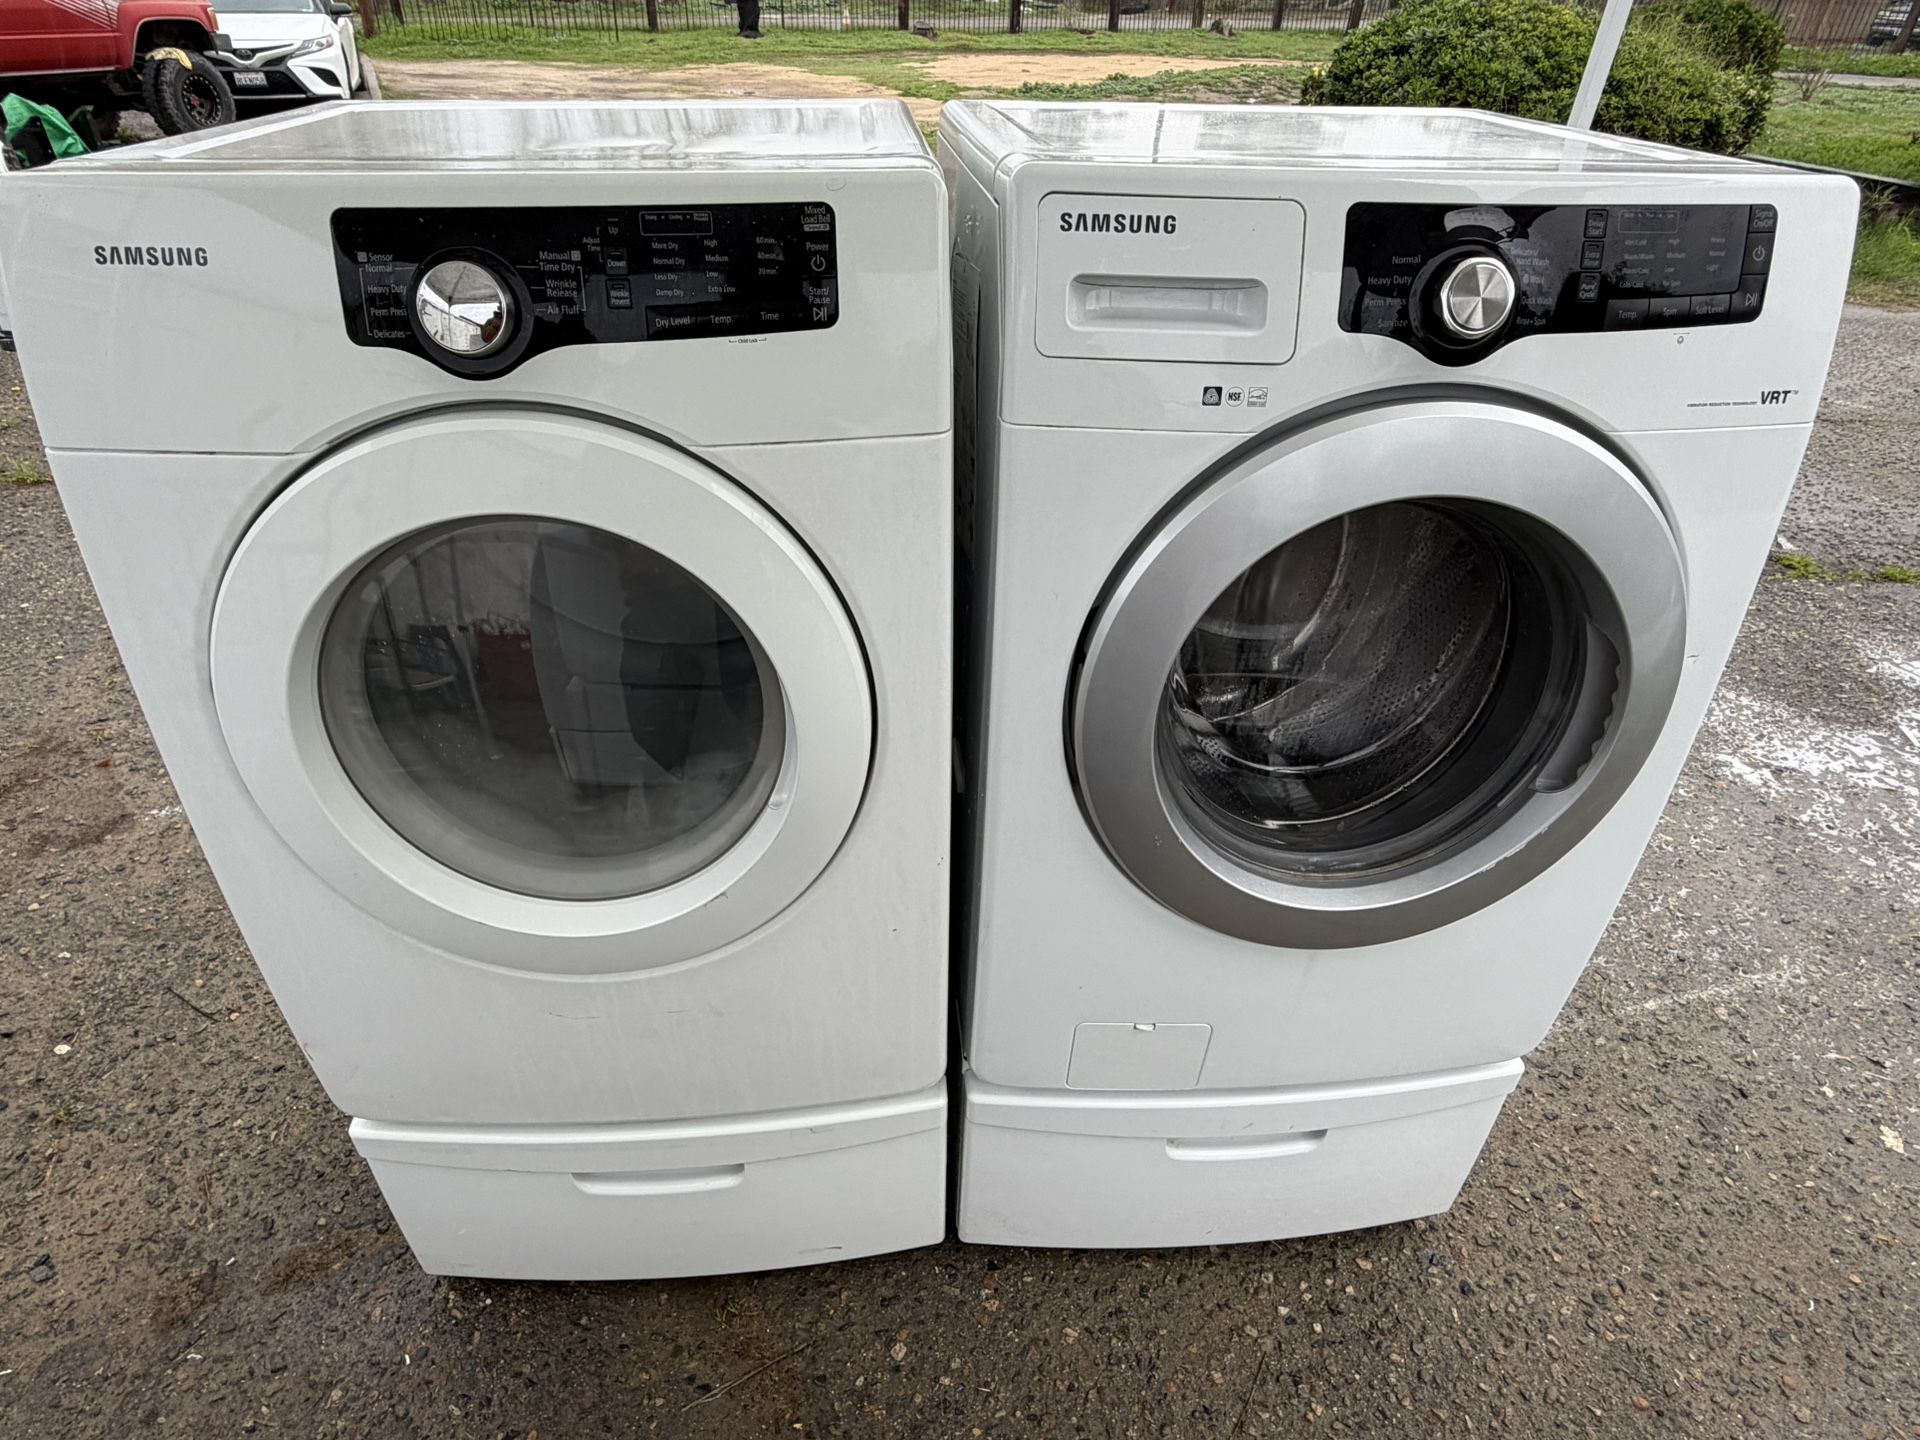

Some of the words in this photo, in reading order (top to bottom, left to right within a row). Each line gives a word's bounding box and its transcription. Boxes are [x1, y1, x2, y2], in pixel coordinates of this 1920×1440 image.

[804, 206, 826, 215] Mixed
[1754, 209, 1774, 220] Signal
[801, 214, 817, 224] Load
[818, 213, 831, 223] Bell
[1059, 212, 1177, 234] SAMSUNG
[608, 225, 619, 236] Up
[582, 236, 600, 245] Adjust
[703, 238, 718, 249] High
[806, 241, 829, 251] Power
[652, 241, 667, 250] More
[668, 241, 679, 252] Dry
[93, 245, 208, 267] SAMSUNG
[368, 252, 394, 262] Sensor
[539, 250, 570, 261] Manual
[705, 254, 729, 263] Medium
[1391, 254, 1421, 265] Normal
[607, 258, 627, 268] Down
[653, 256, 674, 265] Normal
[675, 256, 686, 267] Dry
[365, 263, 393, 273] Normal
[539, 261, 560, 272] Time
[561, 262, 576, 274] Dry
[654, 272, 667, 281] Less
[668, 272, 678, 283] Dry
[706, 270, 719, 279] Low
[545, 279, 577, 290] Wrinkle
[1367, 275, 1392, 287] Heavy
[1393, 274, 1412, 287] Duty
[367, 284, 390, 296] Heavy
[391, 284, 407, 296] Duty
[546, 289, 578, 299] Release
[708, 285, 722, 293] Extra
[723, 284, 736, 293] Low
[808, 286, 830, 296] Start/
[808, 296, 831, 305] Pause
[1364, 298, 1384, 307] Perm
[370, 307, 389, 317] Perm
[390, 307, 408, 317] Press
[547, 304, 559, 315] Air
[561, 304, 580, 315] Fluff
[1663, 306, 1678, 317] Spin
[1708, 304, 1725, 315] Level
[710, 314, 735, 325] Temp.
[760, 311, 780, 321] Time
[1618, 310, 1638, 321] Temp.
[655, 317, 669, 329] Dry
[670, 315, 691, 326] Level
[373, 330, 406, 339] Delicates
[1227, 391, 1242, 402] NSF
[1761, 390, 1791, 405] VRT
